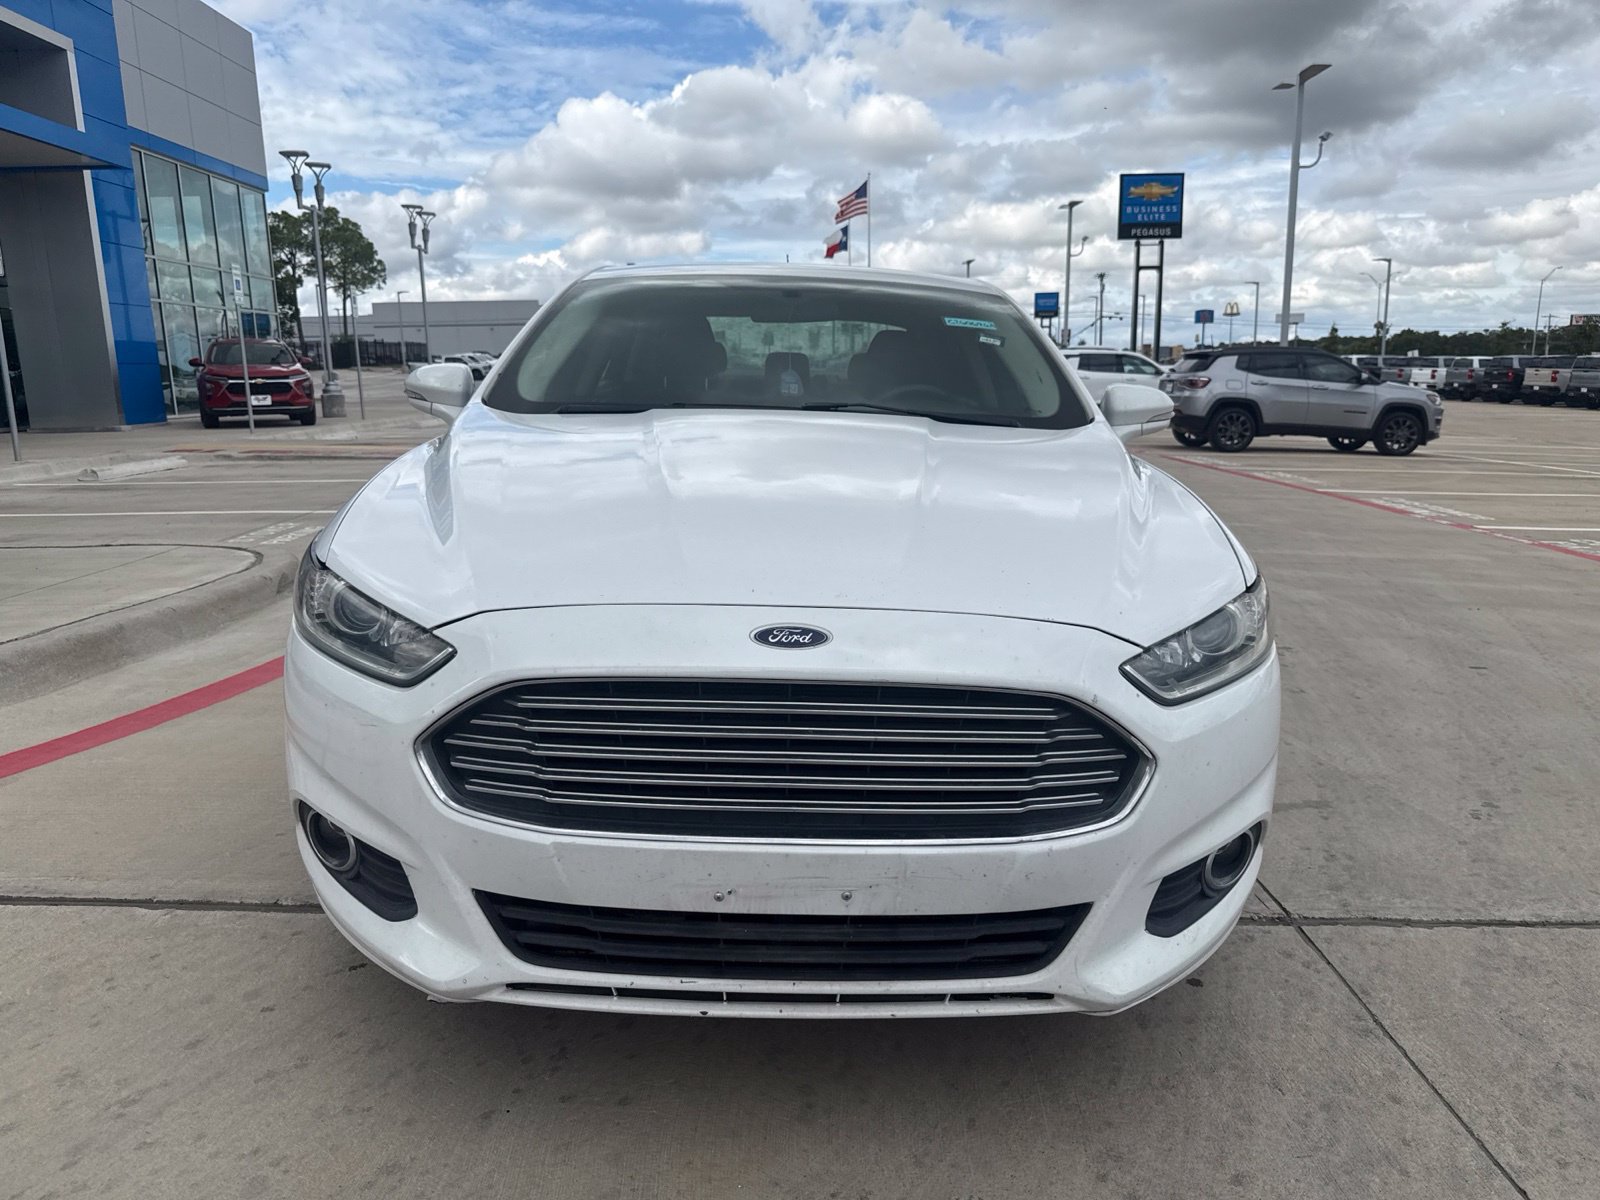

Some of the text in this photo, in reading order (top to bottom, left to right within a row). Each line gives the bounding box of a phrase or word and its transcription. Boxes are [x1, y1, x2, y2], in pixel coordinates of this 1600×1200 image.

[1126, 205, 1178, 213] BUSINESS
[1137, 213, 1166, 221] ELITE
[1131, 227, 1172, 237] PEGASUS
[768, 628, 813, 643] Ford
